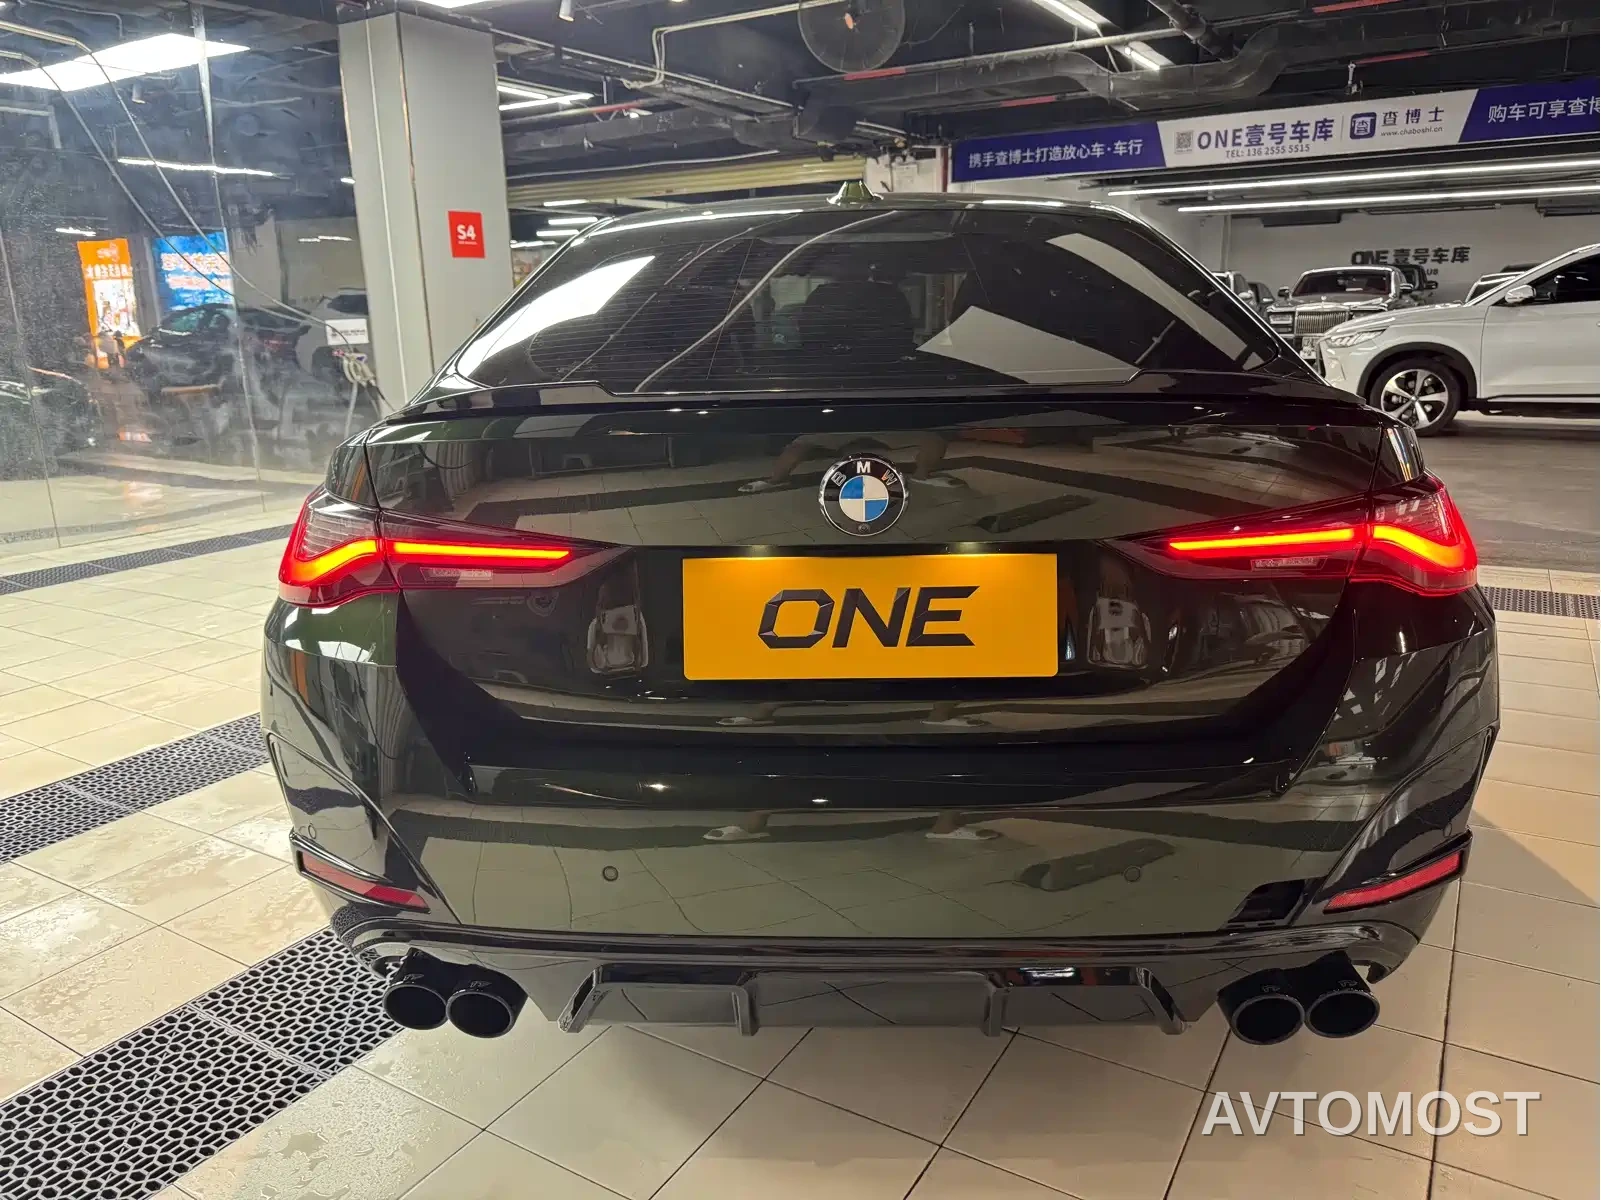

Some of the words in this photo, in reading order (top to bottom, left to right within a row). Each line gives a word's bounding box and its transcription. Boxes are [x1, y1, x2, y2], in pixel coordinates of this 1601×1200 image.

[1197, 118, 1334, 149] ONE壹号车库
[1226, 149, 1244, 158] TEL:
[1247, 147, 1262, 157] 136
[1264, 145, 1286, 155] 2555
[1288, 143, 1310, 153] 5515
[456, 224, 476, 241] S4
[830, 460, 898, 487] BMW
[757, 585, 980, 649] ONE
